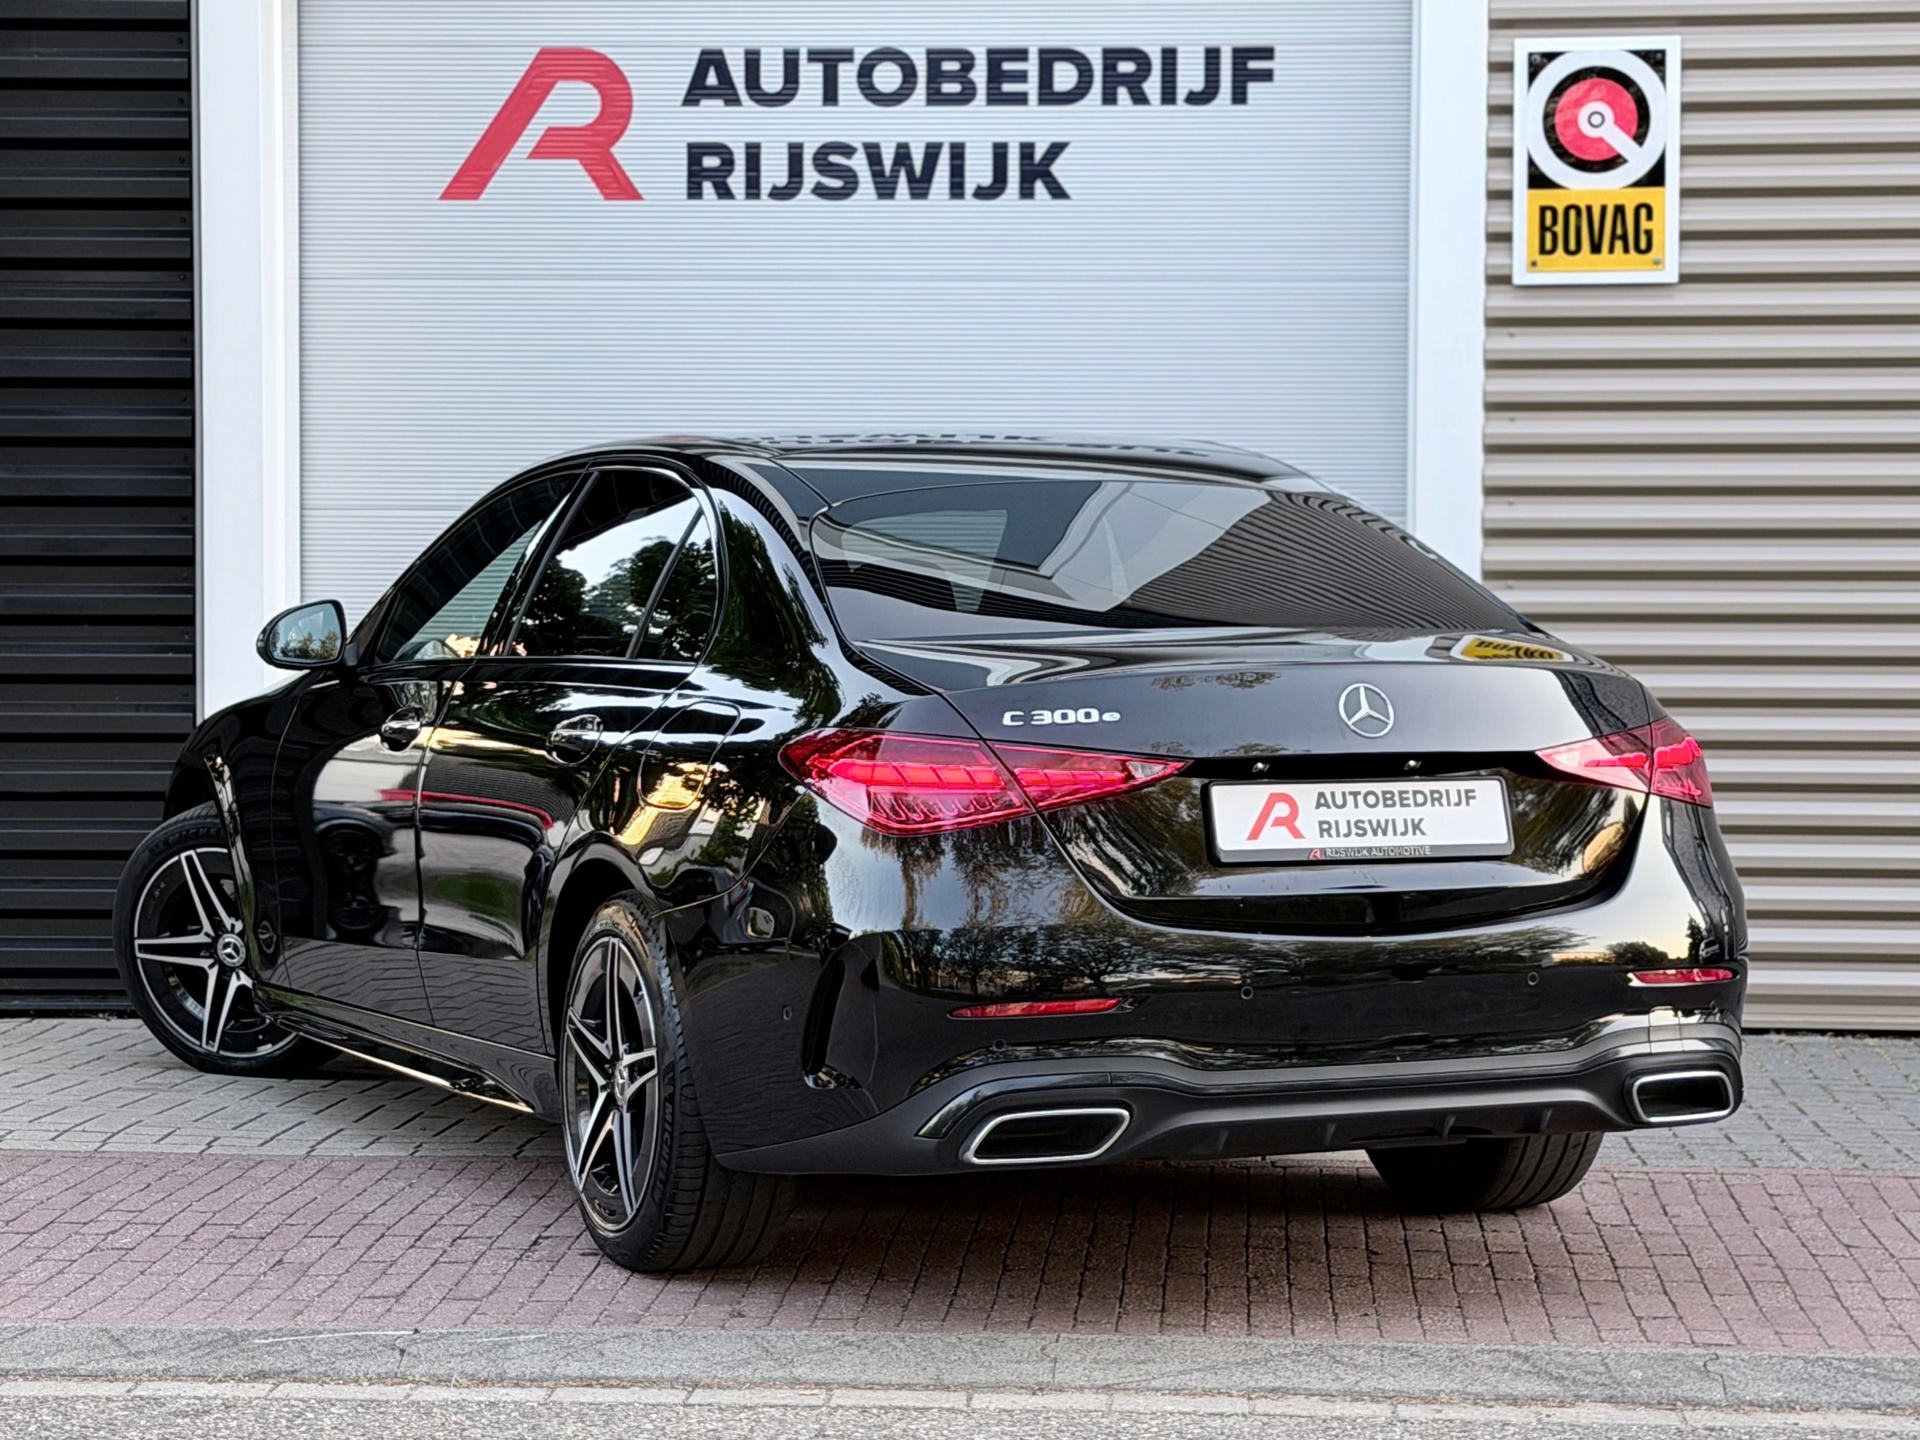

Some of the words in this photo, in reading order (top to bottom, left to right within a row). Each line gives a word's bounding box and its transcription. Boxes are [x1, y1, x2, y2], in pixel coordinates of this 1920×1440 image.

[681, 47, 1275, 107] AUTOBEDRIJF
[686, 142, 1071, 200] RIJSWIJK
[1538, 203, 1654, 256] BOVAG
[1002, 711, 1025, 726] C
[1314, 789, 1477, 809] AUTOBEDRIJF
[1318, 818, 1427, 838] RIJSWIJK
[1325, 848, 1369, 858] RIJSWIJK
[1371, 846, 1431, 857] AUTOMOTIVE
